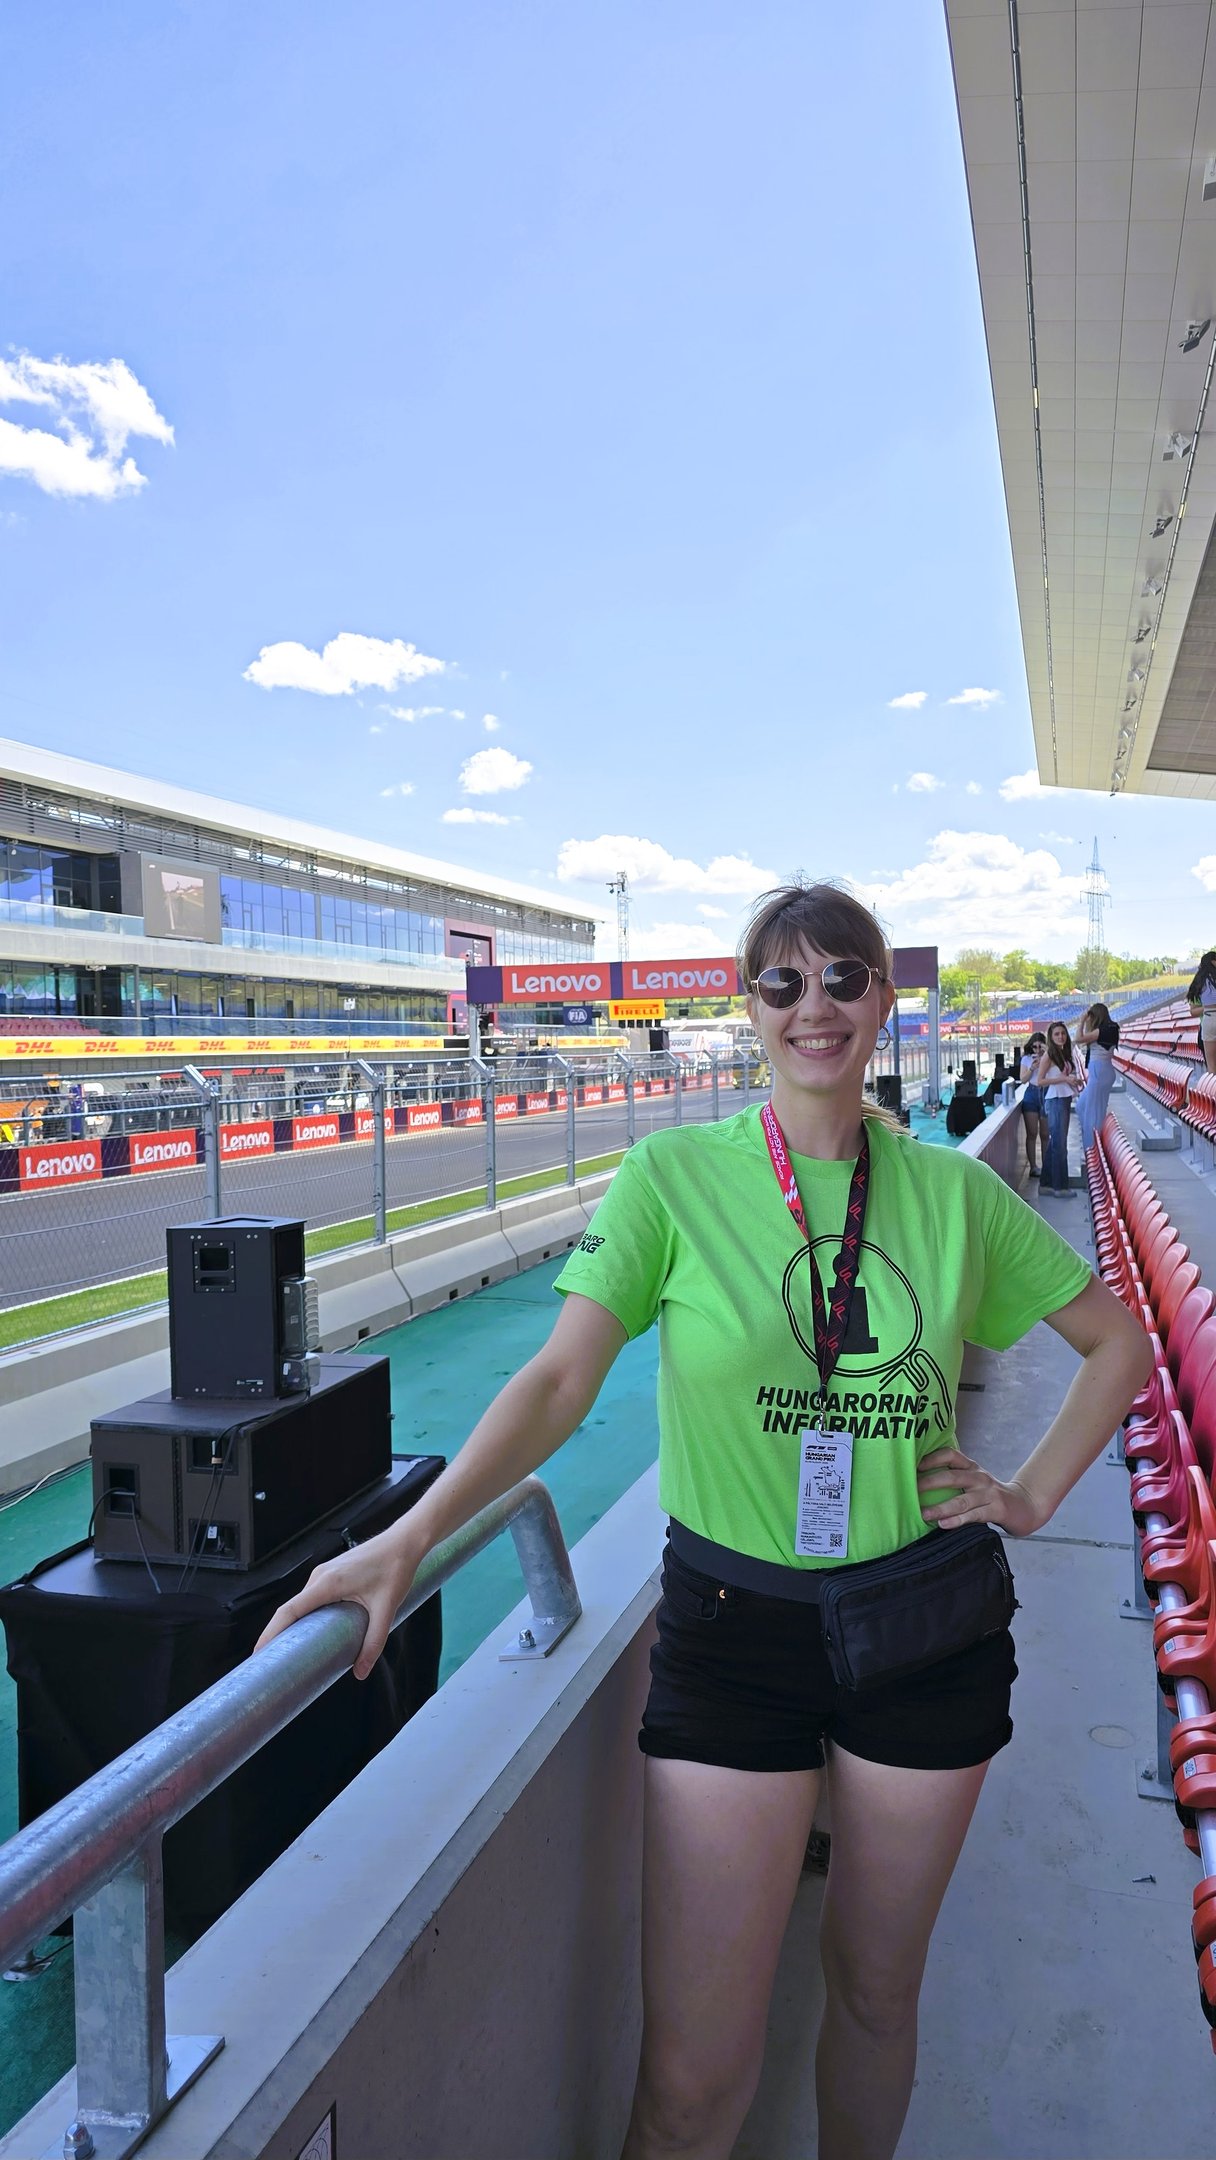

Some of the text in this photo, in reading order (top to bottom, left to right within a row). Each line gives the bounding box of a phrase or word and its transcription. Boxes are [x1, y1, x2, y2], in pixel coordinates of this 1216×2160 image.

[511, 973, 602, 994] Lenovo
[631, 968, 728, 990] Lenovo
[568, 1011, 587, 1021] FIA
[614, 1003, 660, 1016] PIRELLI
[15, 1041, 55, 1054] DHL
[84, 1041, 119, 1053] DHL
[145, 1041, 176, 1052] DHL
[199, 1041, 226, 1051] DHL
[247, 1041, 272, 1050] DHL
[289, 1041, 312, 1050] DHL
[328, 1040, 348, 1049] DHL
[363, 1040, 381, 1049] DHL
[394, 1040, 410, 1048] DHL
[527, 1097, 548, 1110] Lenovo
[410, 1111, 440, 1126] Lenovo
[455, 1106, 480, 1120] Lenovo
[295, 1123, 337, 1141] Lenovo
[357, 1117, 392, 1134] Leno
[222, 1132, 270, 1152] Lenovo
[134, 1141, 192, 1165] Lenovo
[25, 1152, 96, 1179] Lenovo
[756, 1386, 929, 1416] HUNGARORING
